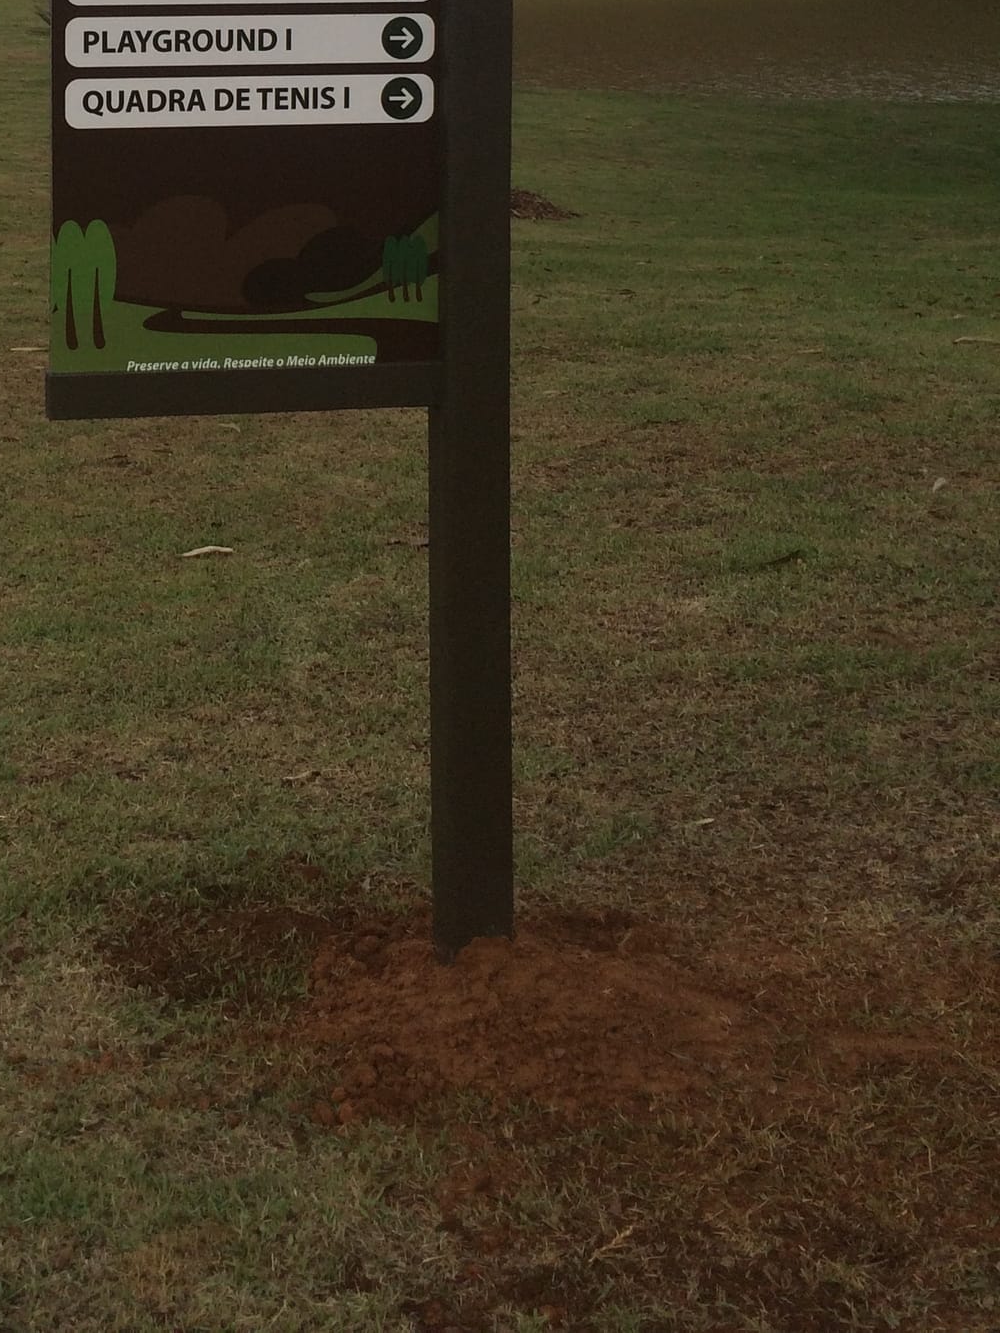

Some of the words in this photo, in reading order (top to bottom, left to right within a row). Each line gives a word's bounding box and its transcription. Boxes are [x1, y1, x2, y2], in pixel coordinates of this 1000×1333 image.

[82, 29, 278, 54] PLAYGROUND
[285, 28, 293, 51] I
[82, 88, 206, 117] QUADRA
[213, 88, 250, 111] DE
[256, 87, 336, 110] TENIS
[343, 86, 351, 109] I
[126, 360, 179, 372] Preserve
[180, 361, 189, 370] a
[191, 358, 221, 370] vida.
[223, 356, 274, 370] Respeite
[276, 358, 284, 368] o
[286, 355, 316, 367] Meio
[318, 353, 375, 366] Ambiente
